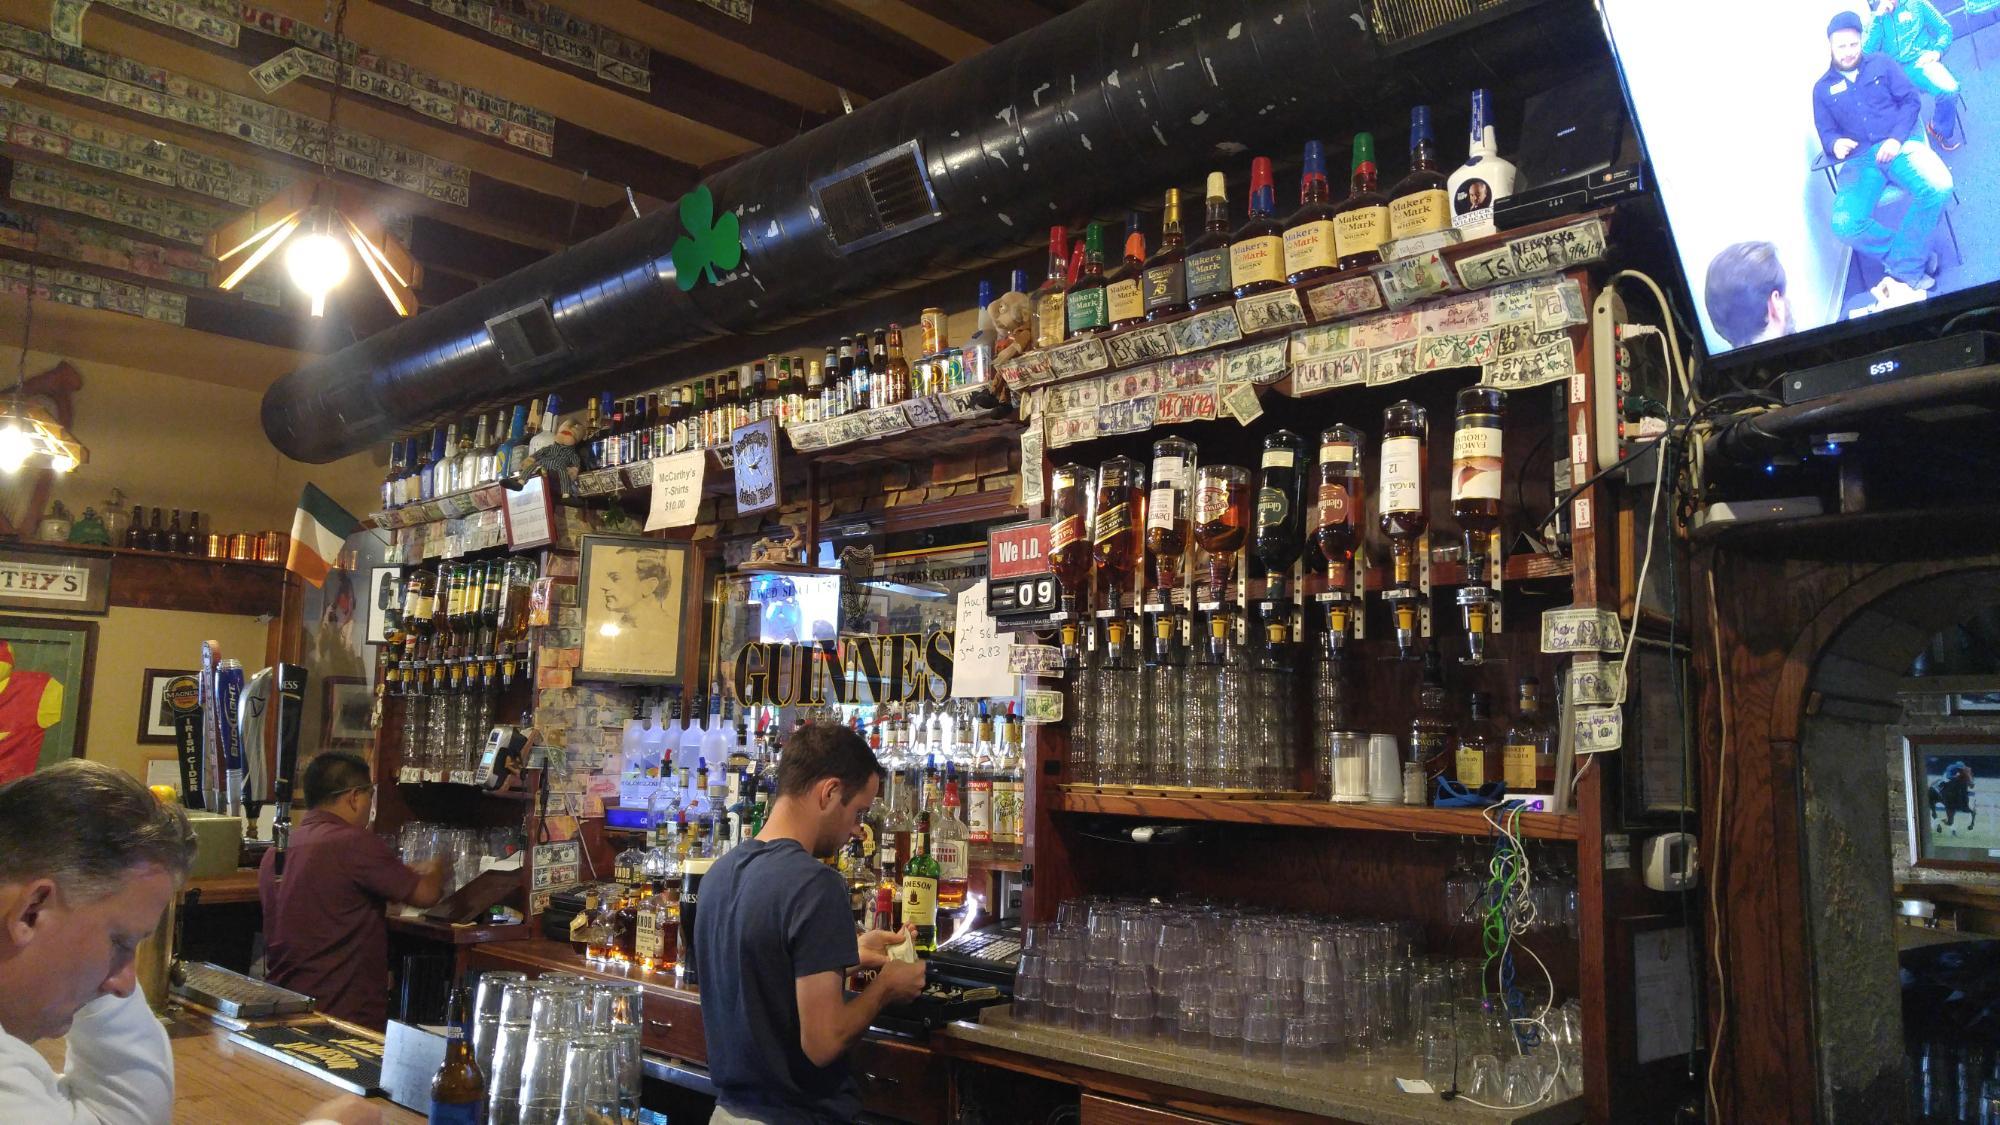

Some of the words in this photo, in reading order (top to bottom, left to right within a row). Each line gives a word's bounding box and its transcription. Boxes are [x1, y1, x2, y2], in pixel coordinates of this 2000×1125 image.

[1393, 195, 1432, 212] Maker's
[1338, 212, 1376, 225] Maker's
[1402, 206, 1432, 218] Mark
[1349, 220, 1376, 231] Mark
[1284, 227, 1319, 242] Maker's
[1293, 236, 1318, 247] Mark
[1233, 241, 1268, 255] Maker's
[1188, 253, 1221, 267] Maker's
[1242, 250, 1267, 261] Mark
[1196, 262, 1221, 273] Mark
[660, 467, 696, 483] McCarthy's
[664, 485, 689, 497] T-Shirts
[665, 499, 686, 512] $10.00
[999, 541, 1018, 563] We
[1022, 537, 1042, 560] I.D.
[1019, 581, 1052, 606] 09
[977, 646, 1001, 659] 283
[734, 630, 955, 707] GUINNES
[184, 718, 196, 753] IRISH
[186, 756, 199, 792] CIDER
